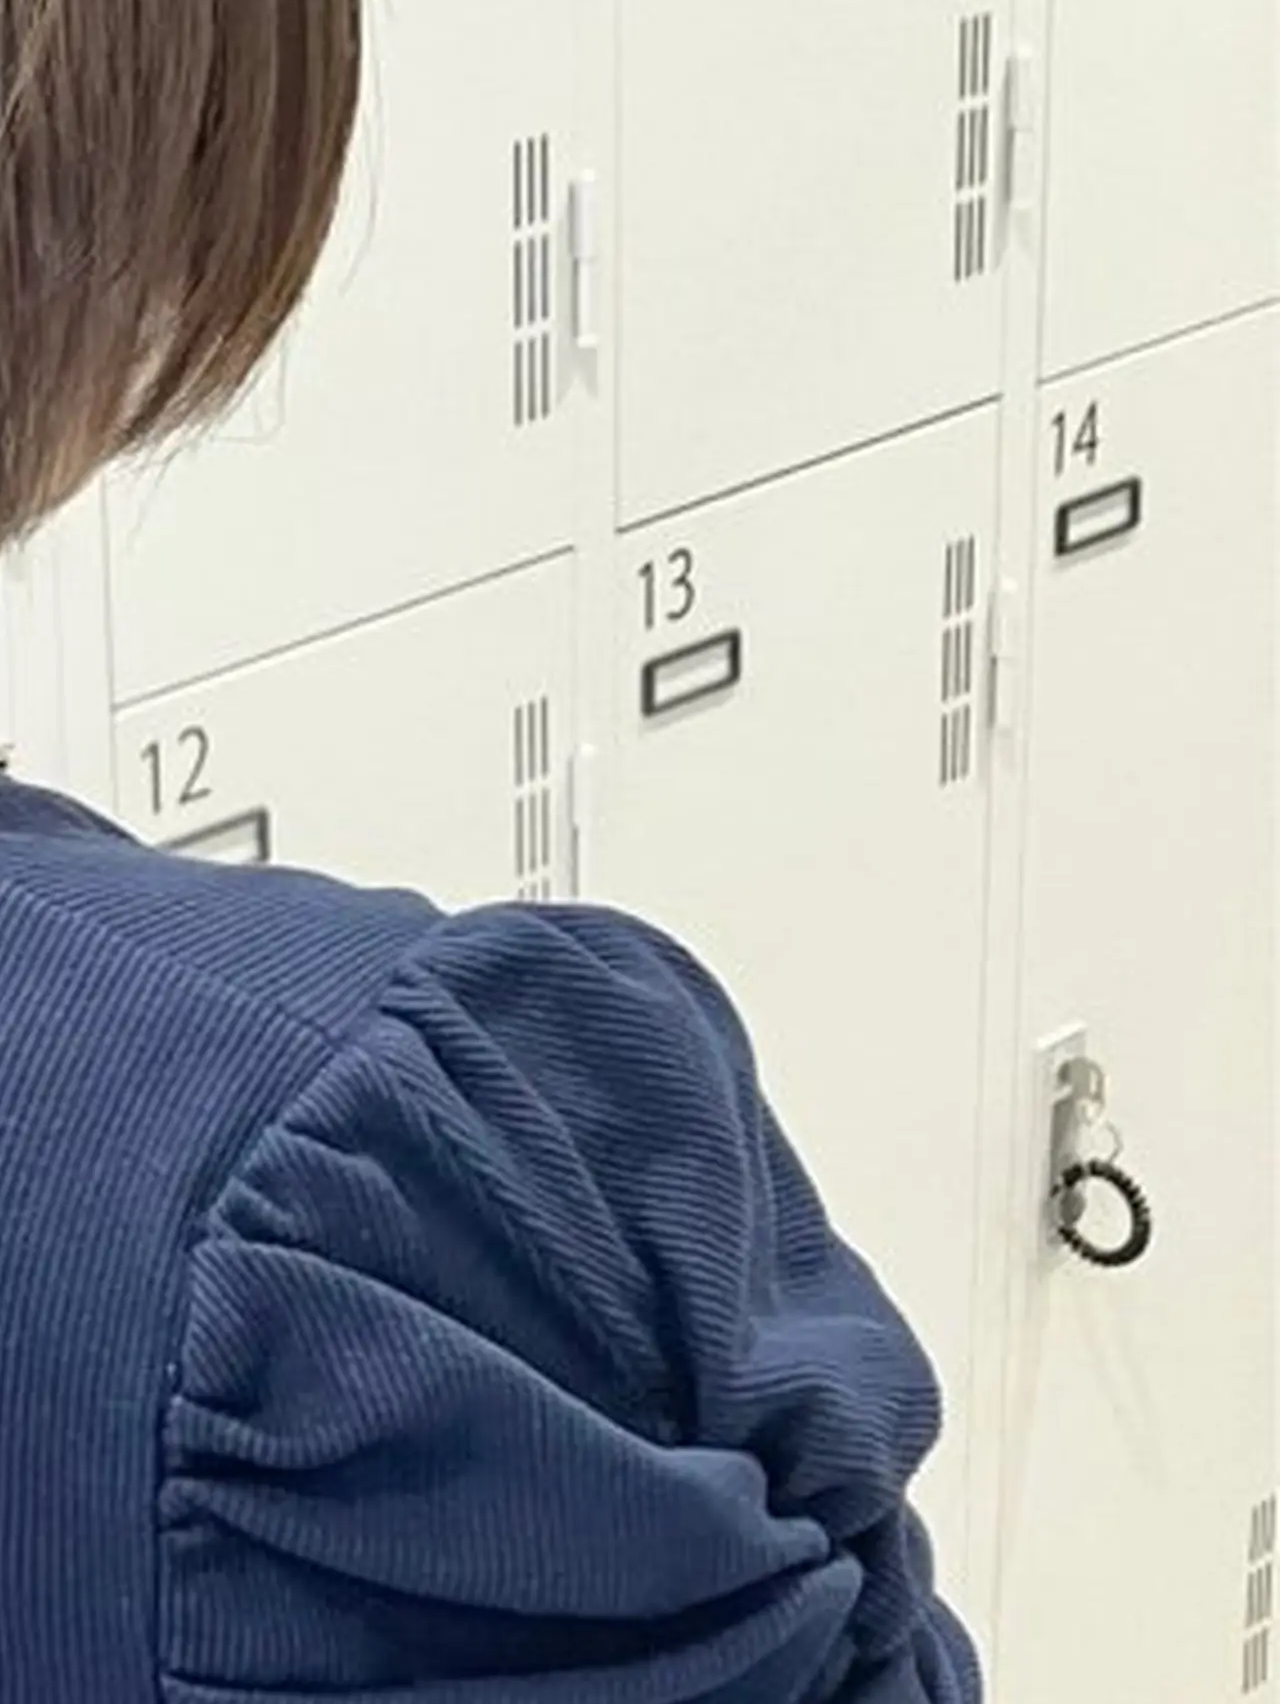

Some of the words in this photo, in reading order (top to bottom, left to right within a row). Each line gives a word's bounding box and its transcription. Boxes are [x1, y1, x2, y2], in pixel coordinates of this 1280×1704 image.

[1052, 400, 1099, 477] 14
[639, 548, 695, 630] 13
[140, 725, 212, 814] 12
